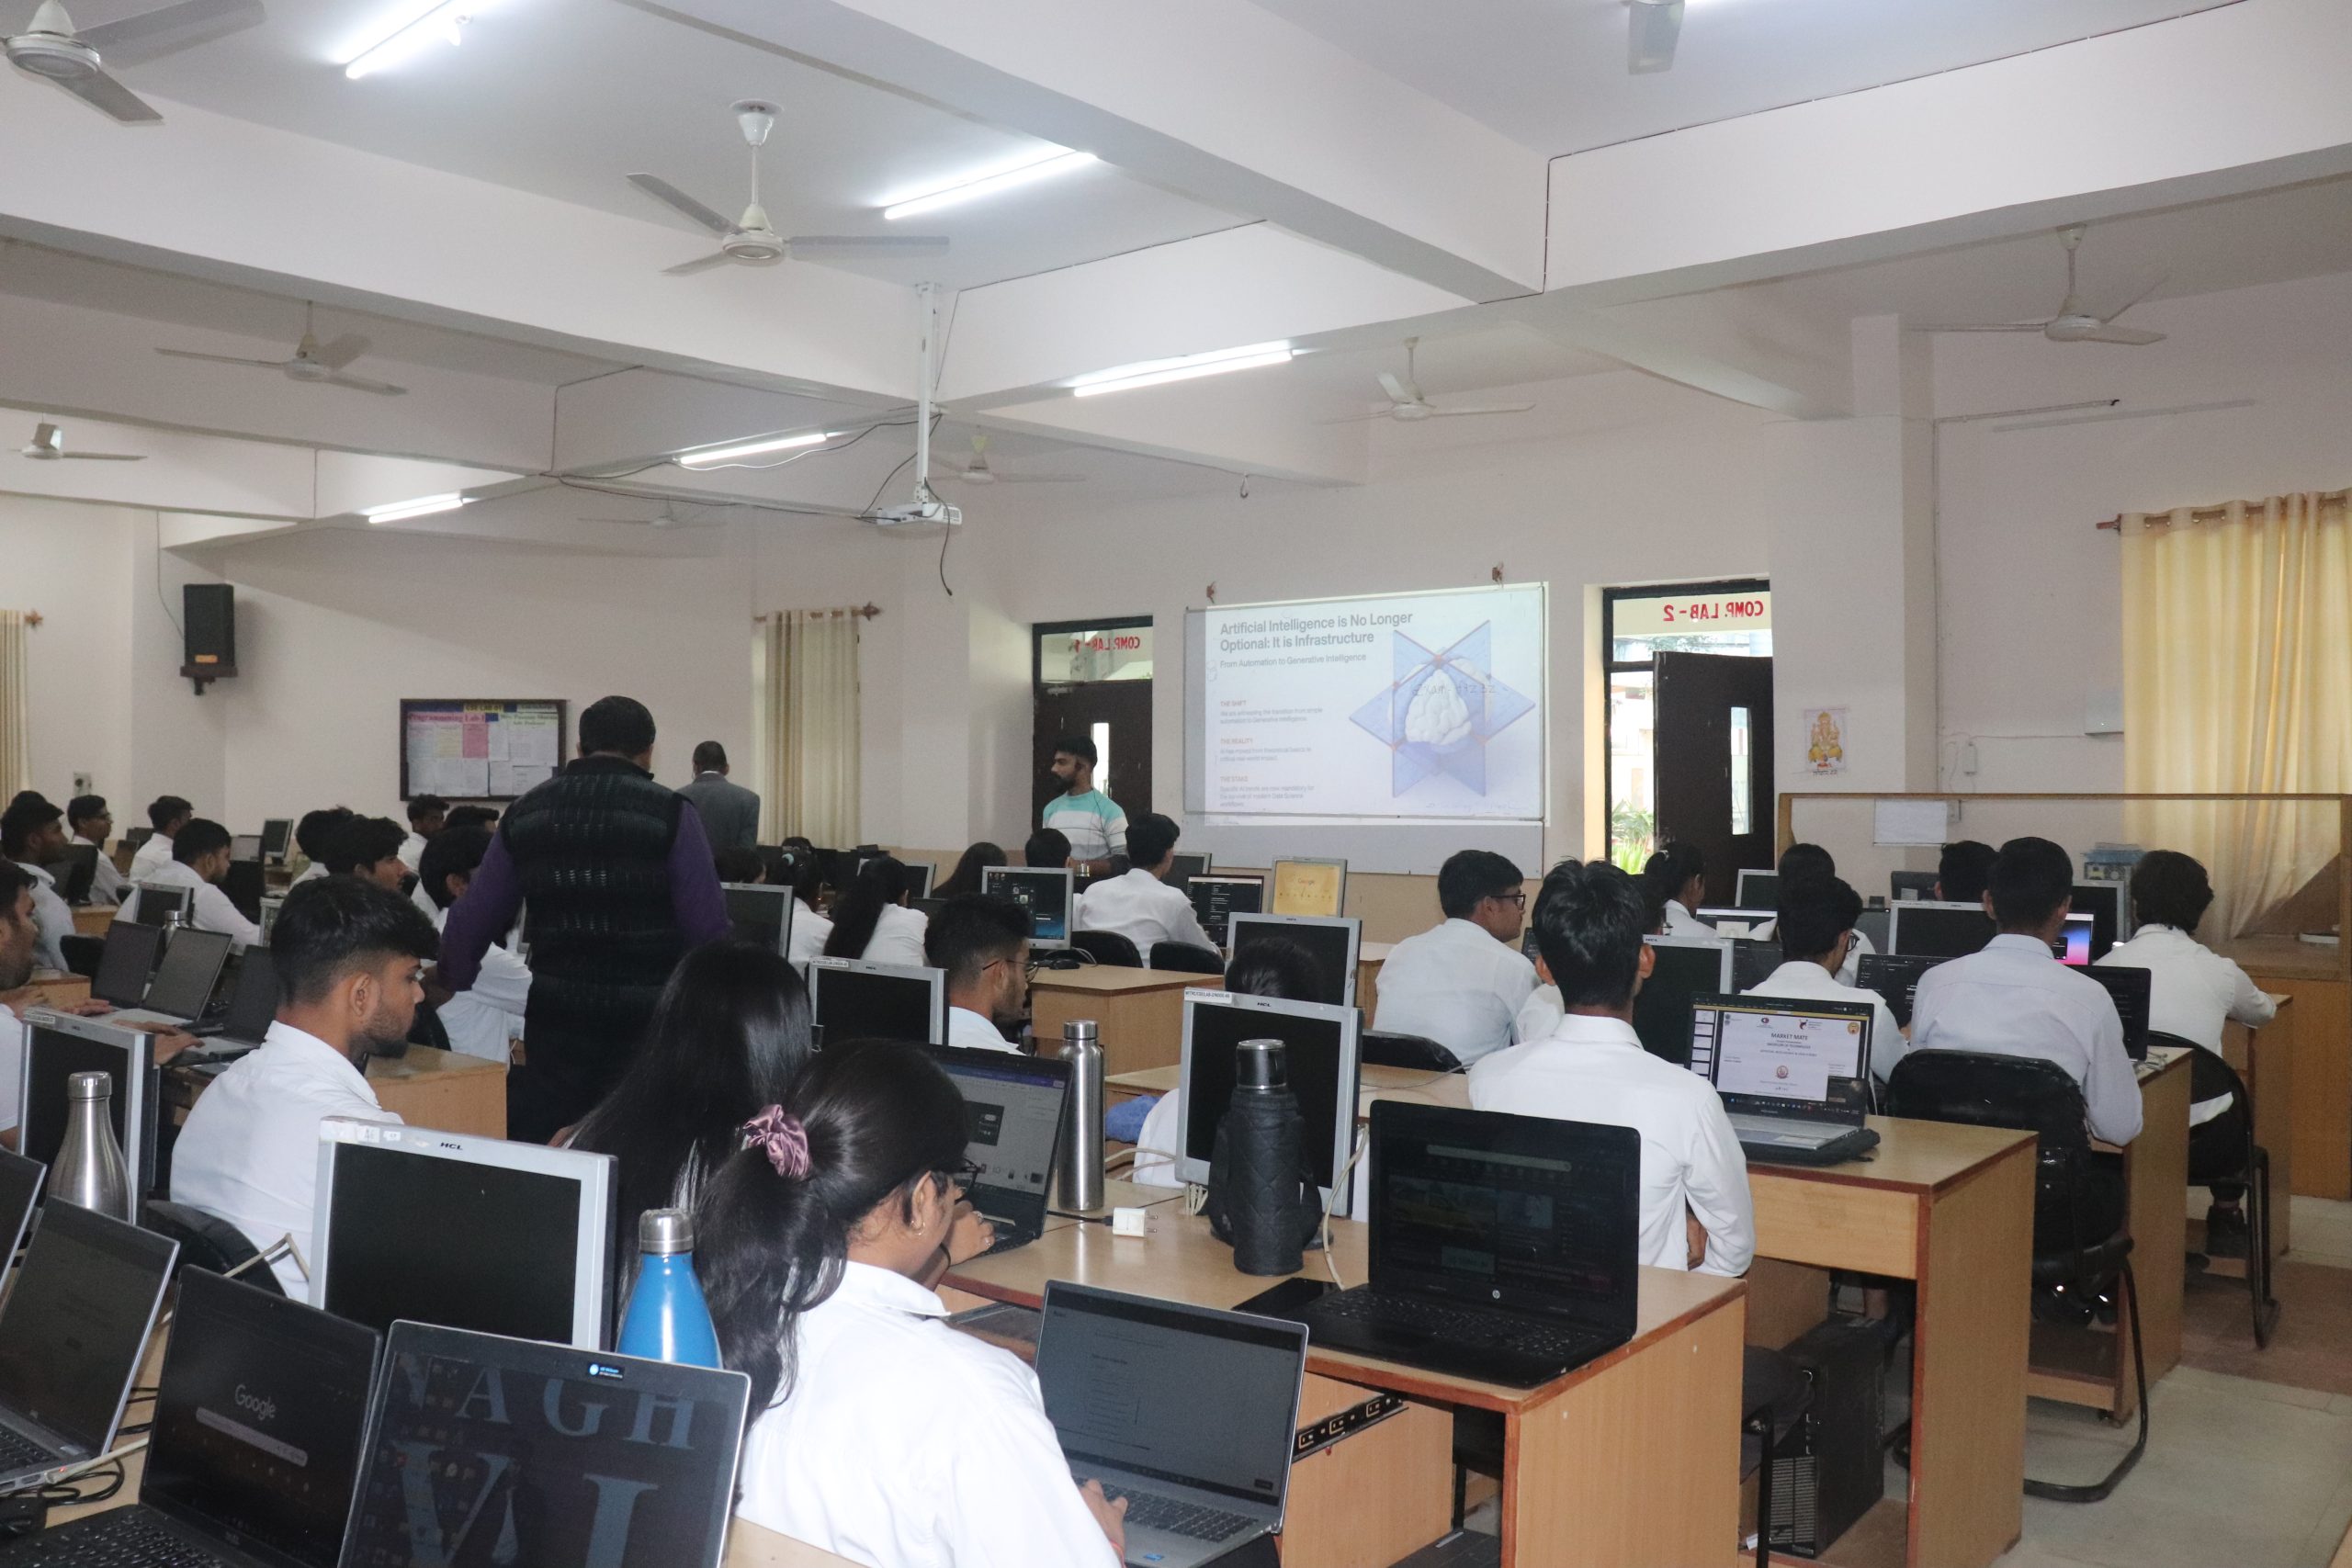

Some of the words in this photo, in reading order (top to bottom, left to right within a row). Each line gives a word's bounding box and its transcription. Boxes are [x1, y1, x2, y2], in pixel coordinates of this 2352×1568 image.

[1220, 620, 1266, 635] Artificial
[1269, 617, 1335, 633] Intelligence
[1338, 615, 1348, 626] is
[1350, 614, 1367, 626] No
[1370, 613, 1413, 626] Longer
[1220, 637, 1270, 653] Optional:
[1272, 637, 1280, 648] It
[1283, 636, 1293, 647] is
[1295, 632, 1374, 647] Infrastructure
[1238, 658, 1277, 667] Automation
[1287, 656, 1324, 664] Generative
[1326, 653, 1366, 663] Intelligence
[440, 1142, 463, 1150] HCL
[234, 1384, 276, 1421] Google
